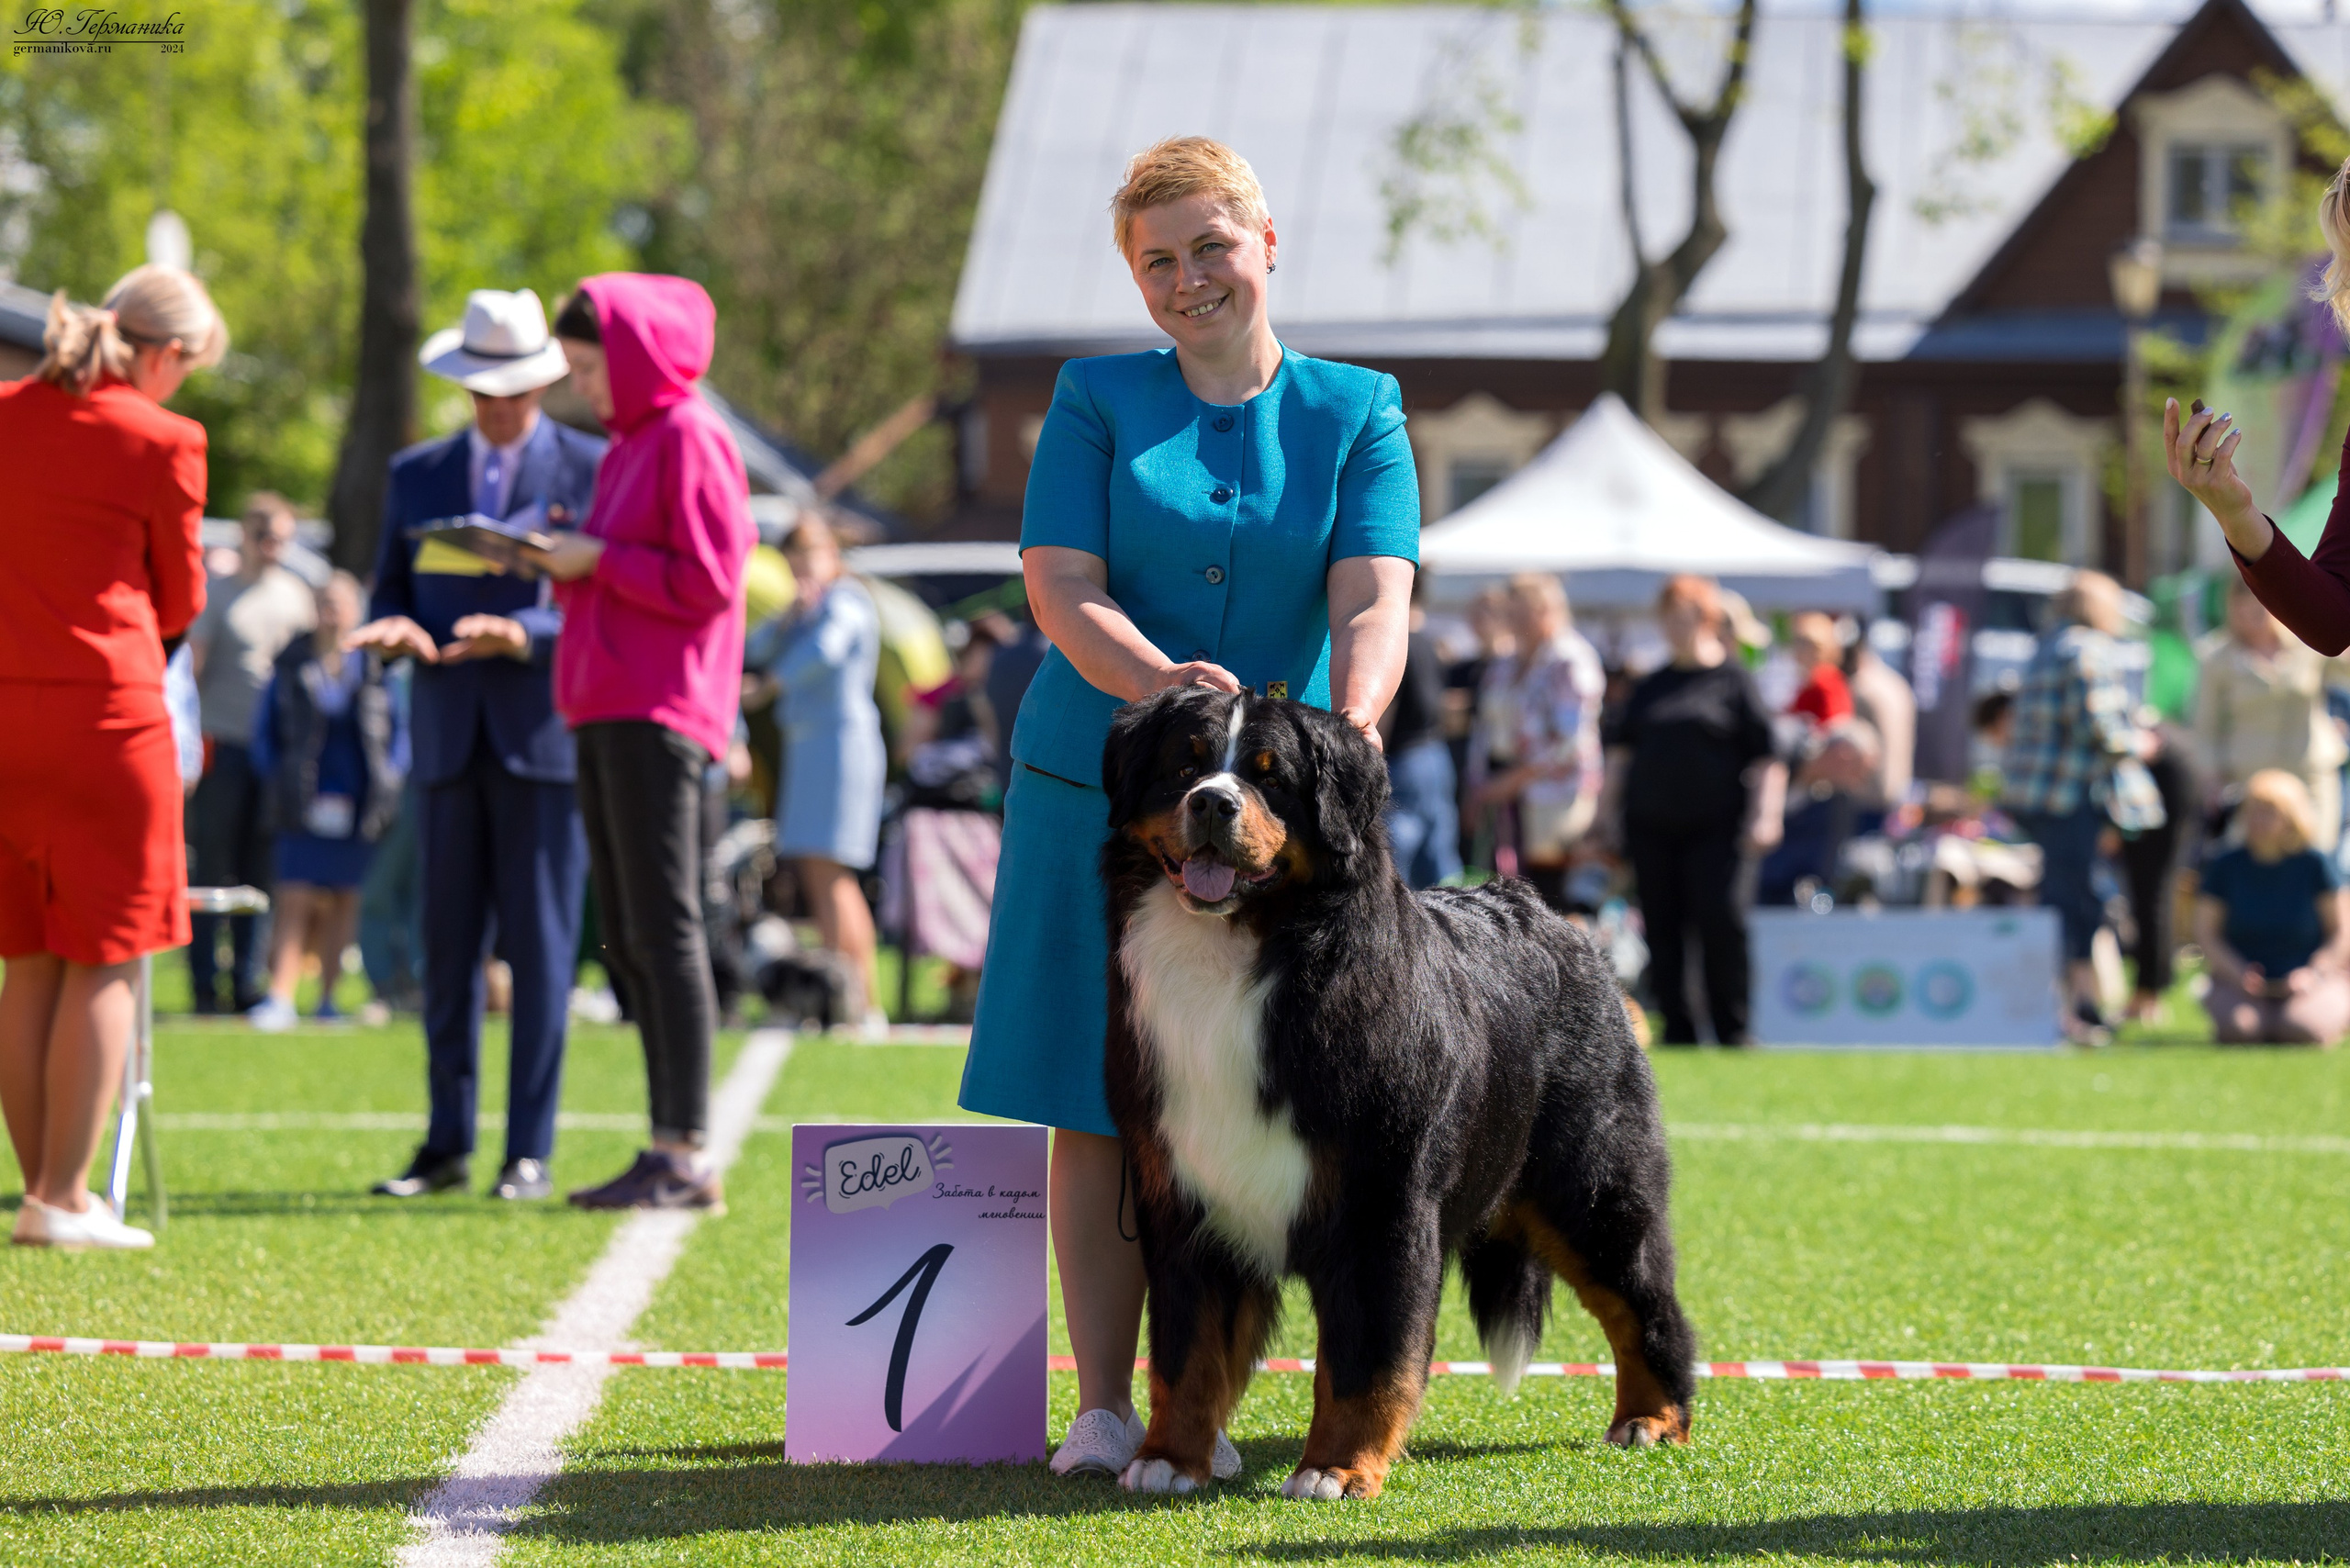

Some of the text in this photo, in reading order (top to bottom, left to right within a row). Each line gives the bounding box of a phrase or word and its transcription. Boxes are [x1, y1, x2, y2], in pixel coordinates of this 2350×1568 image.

[840, 1145, 921, 1197] Edel
[933, 1182, 1041, 1204] Забота в кадом
[978, 1206, 1046, 1219] мгновении
[845, 1243, 955, 1432] 1
